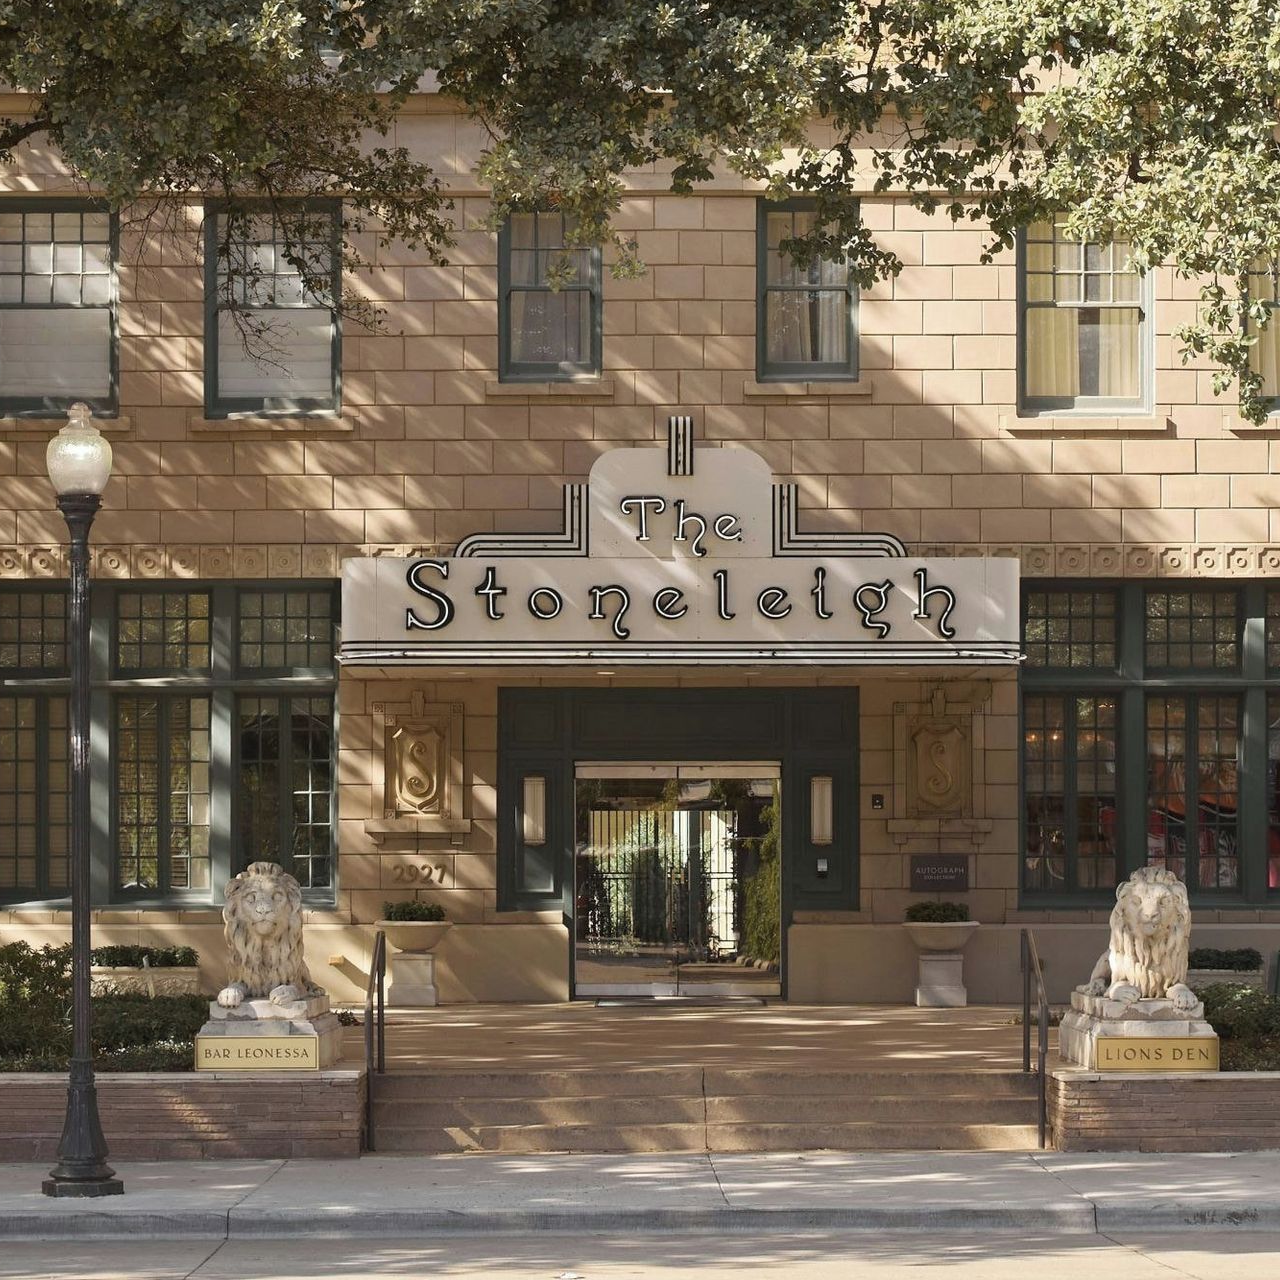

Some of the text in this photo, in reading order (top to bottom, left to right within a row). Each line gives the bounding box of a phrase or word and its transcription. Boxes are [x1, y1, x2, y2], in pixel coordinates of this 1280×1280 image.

[620, 495, 742, 557] The
[406, 560, 957, 640] Stoneleigh
[392, 863, 447, 884] 2927
[204, 1048, 310, 1059] BAR LEONESSA
[1105, 1048, 1209, 1061] LIONS DEN
